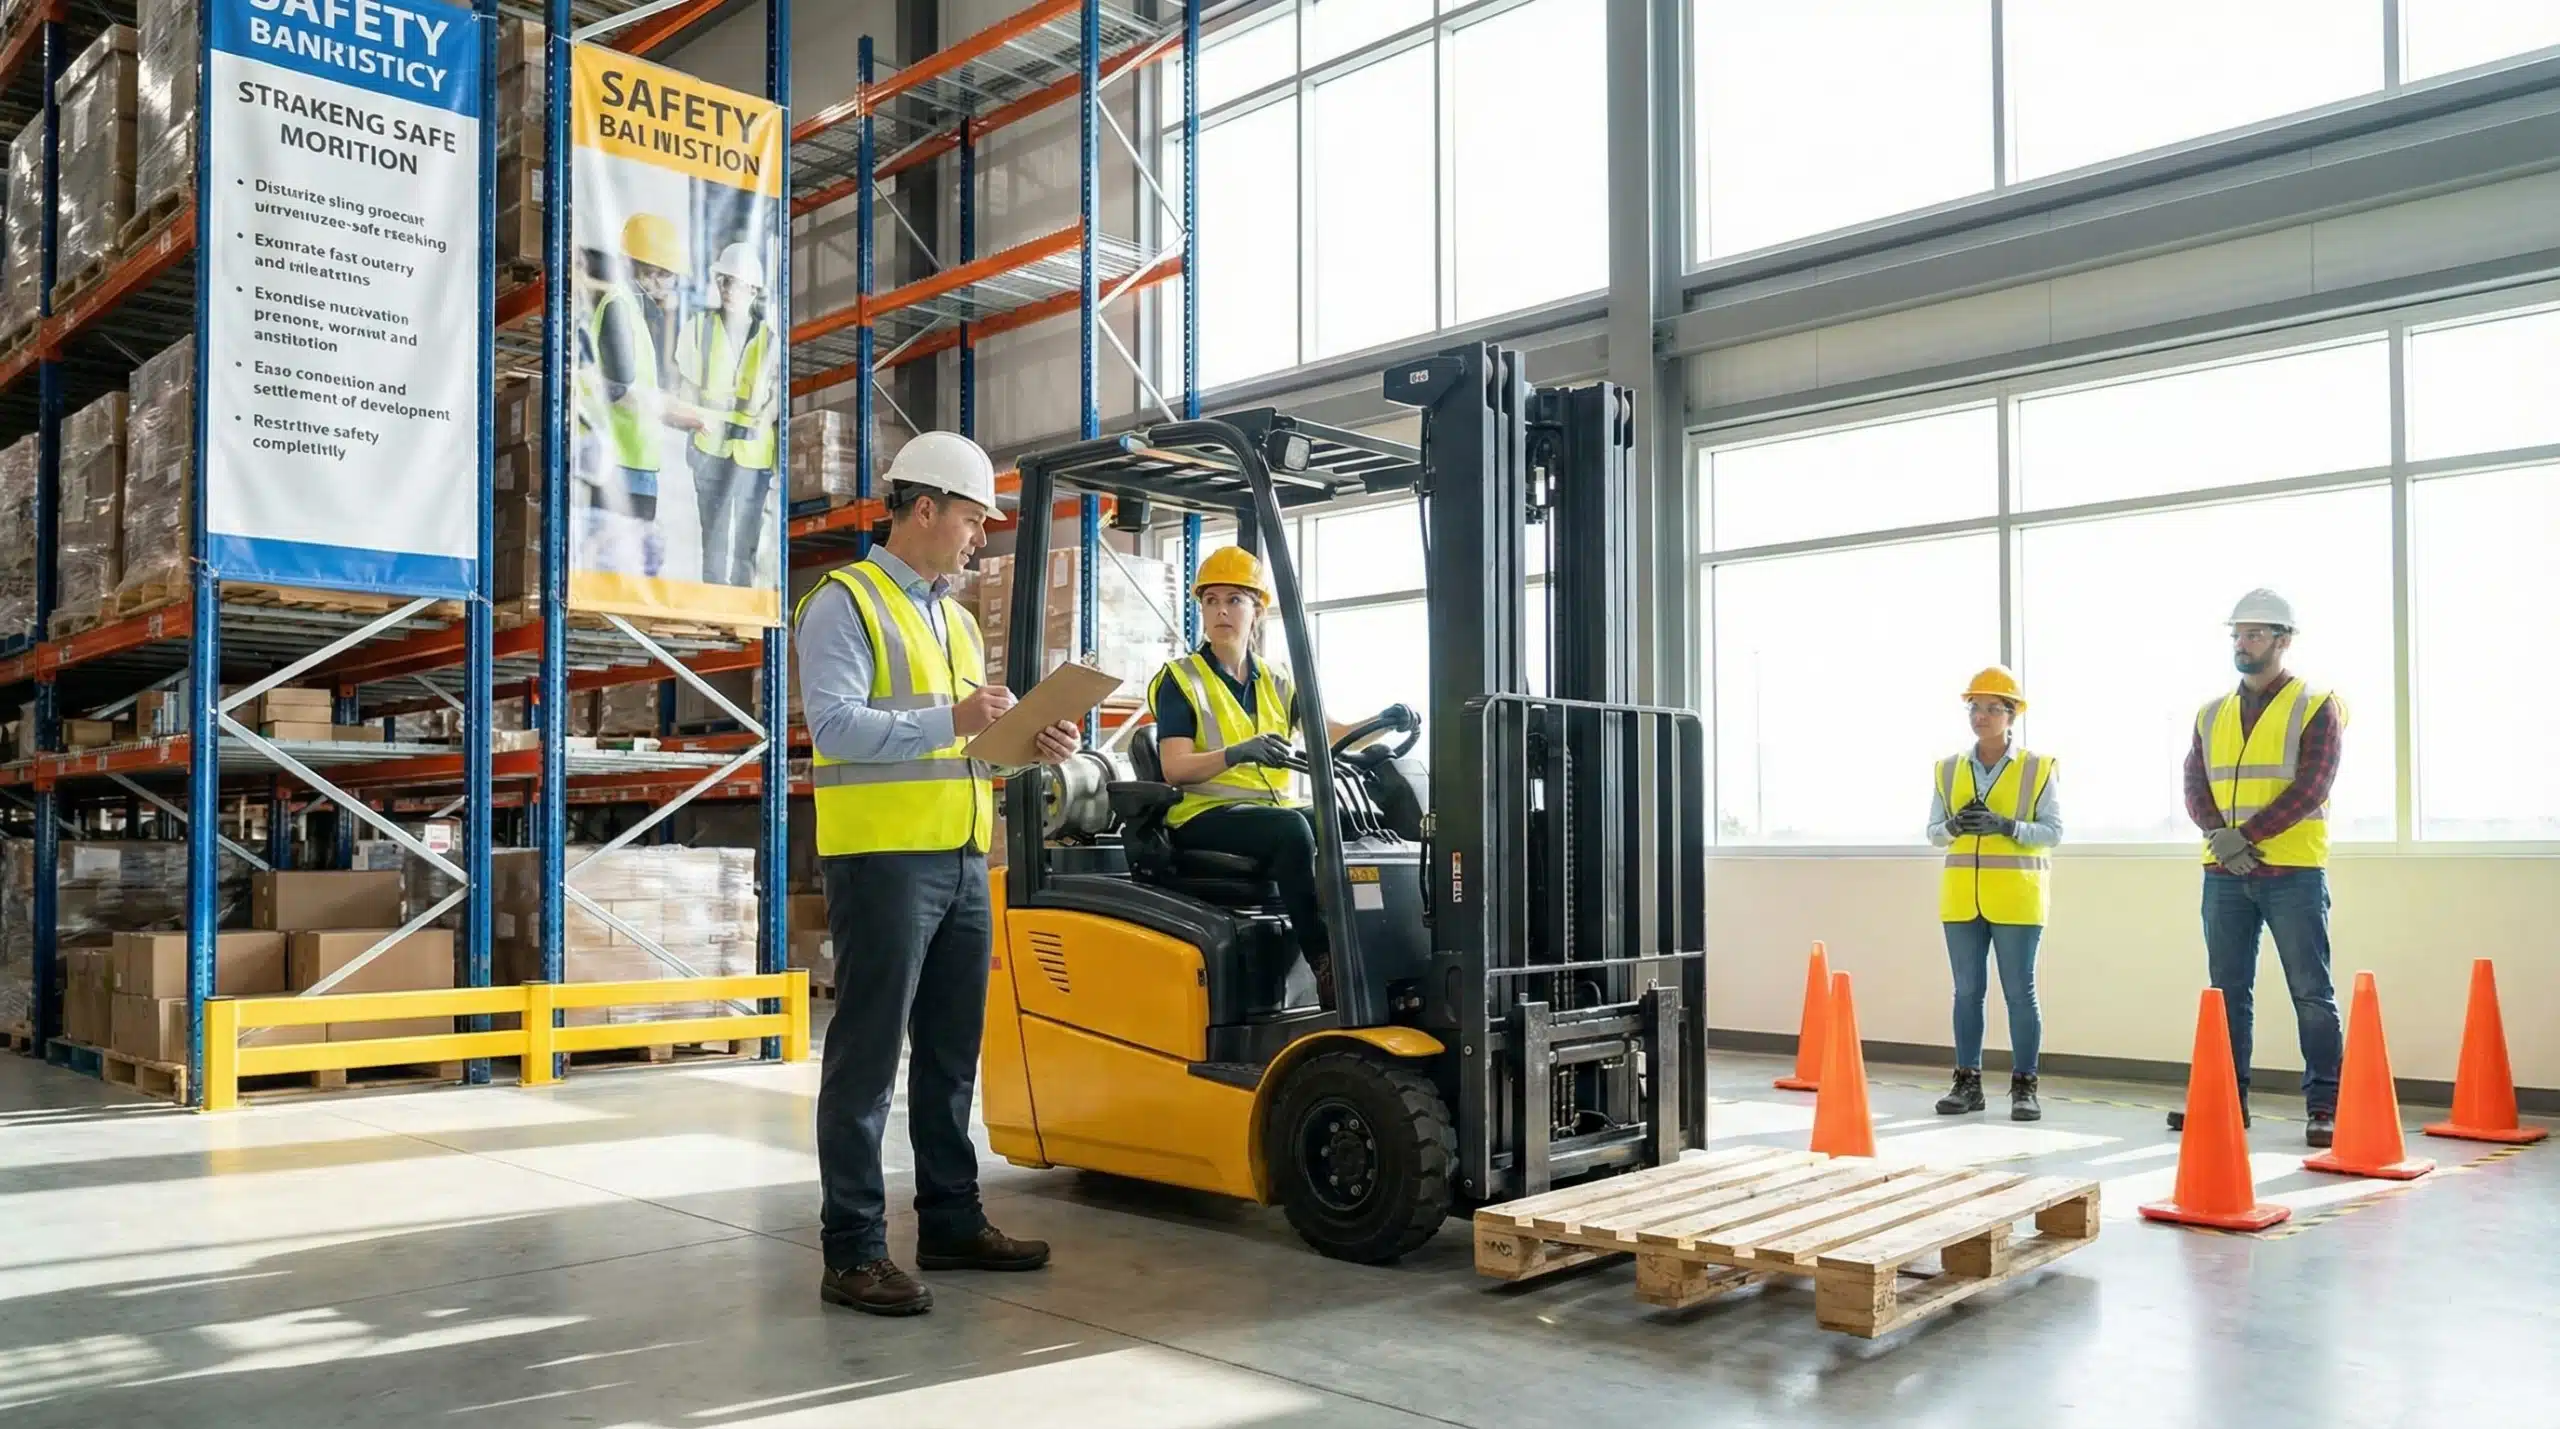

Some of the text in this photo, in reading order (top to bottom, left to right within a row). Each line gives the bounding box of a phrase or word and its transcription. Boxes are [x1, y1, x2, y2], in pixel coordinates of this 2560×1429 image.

[601, 71, 758, 144] SAFETY
[238, 81, 456, 153] STRAKENG SAFE
[281, 124, 417, 174] MORITION
[329, 196, 364, 215] sling
[255, 256, 285, 270] and
[330, 247, 358, 264] fast
[390, 334, 417, 346] and
[253, 384, 338, 405] settlement
[342, 396, 357, 408] of
[379, 383, 406, 395] and
[333, 427, 379, 445] safety
